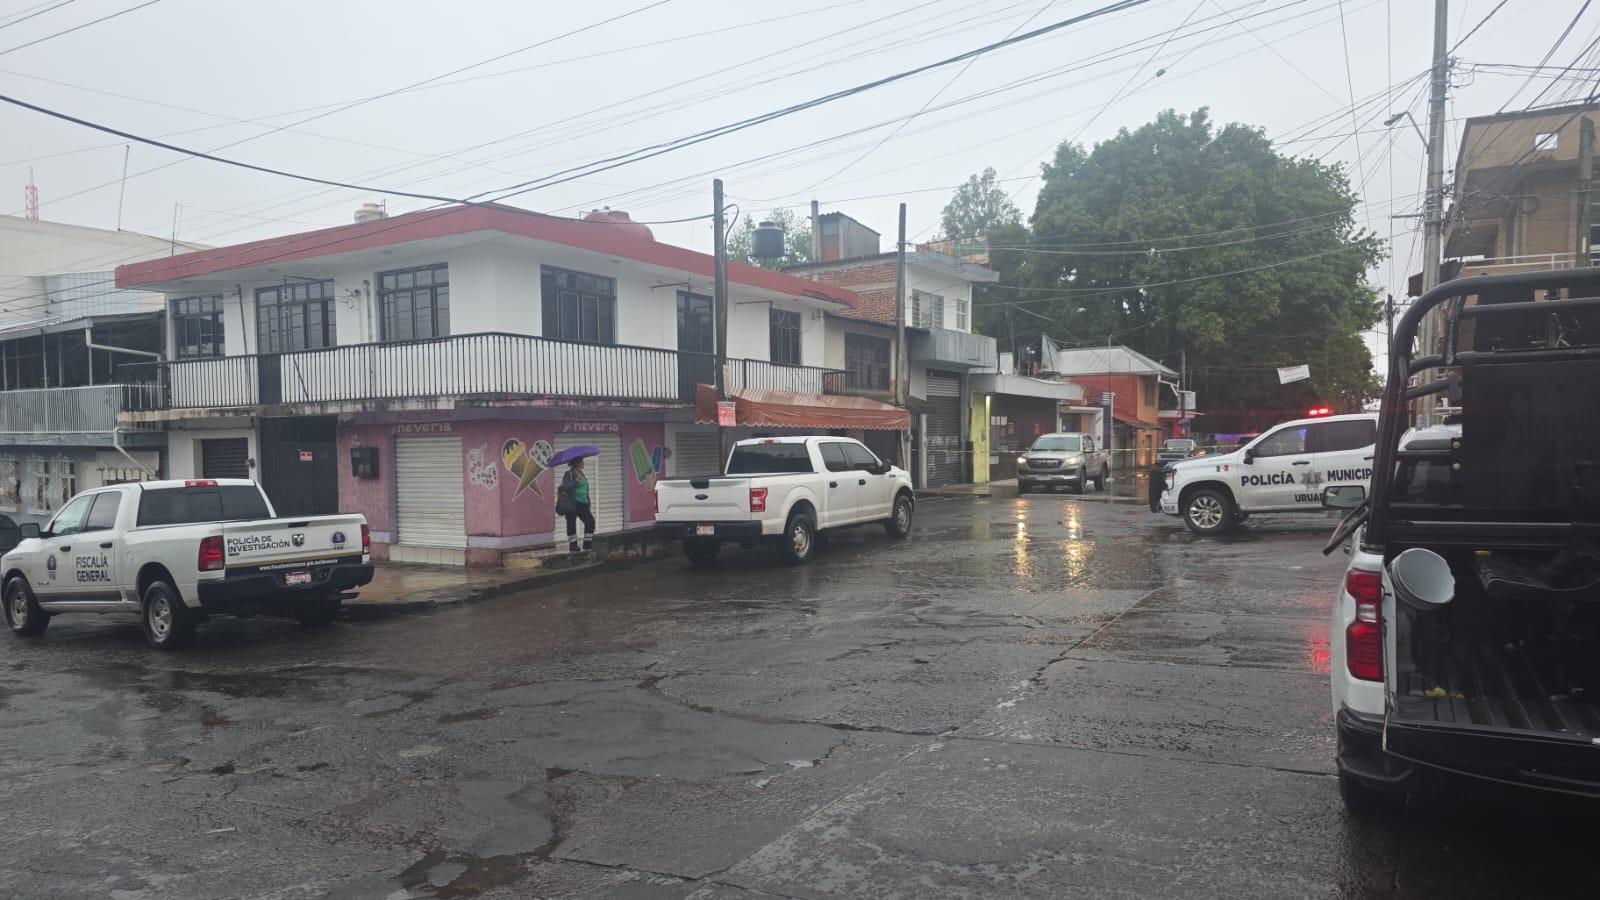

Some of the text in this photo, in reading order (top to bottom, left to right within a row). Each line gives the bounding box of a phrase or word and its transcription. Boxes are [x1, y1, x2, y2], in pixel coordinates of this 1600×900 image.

[1240, 468, 1372, 486] POLICÍA MUNICIP
[1294, 492, 1322, 503] URUA
[227, 535, 260, 545] POLICÍA
[227, 539, 290, 552] INVESTIGACIÓN
[76, 552, 108, 568] FISCALÍA
[76, 570, 111, 582] GENERAL
